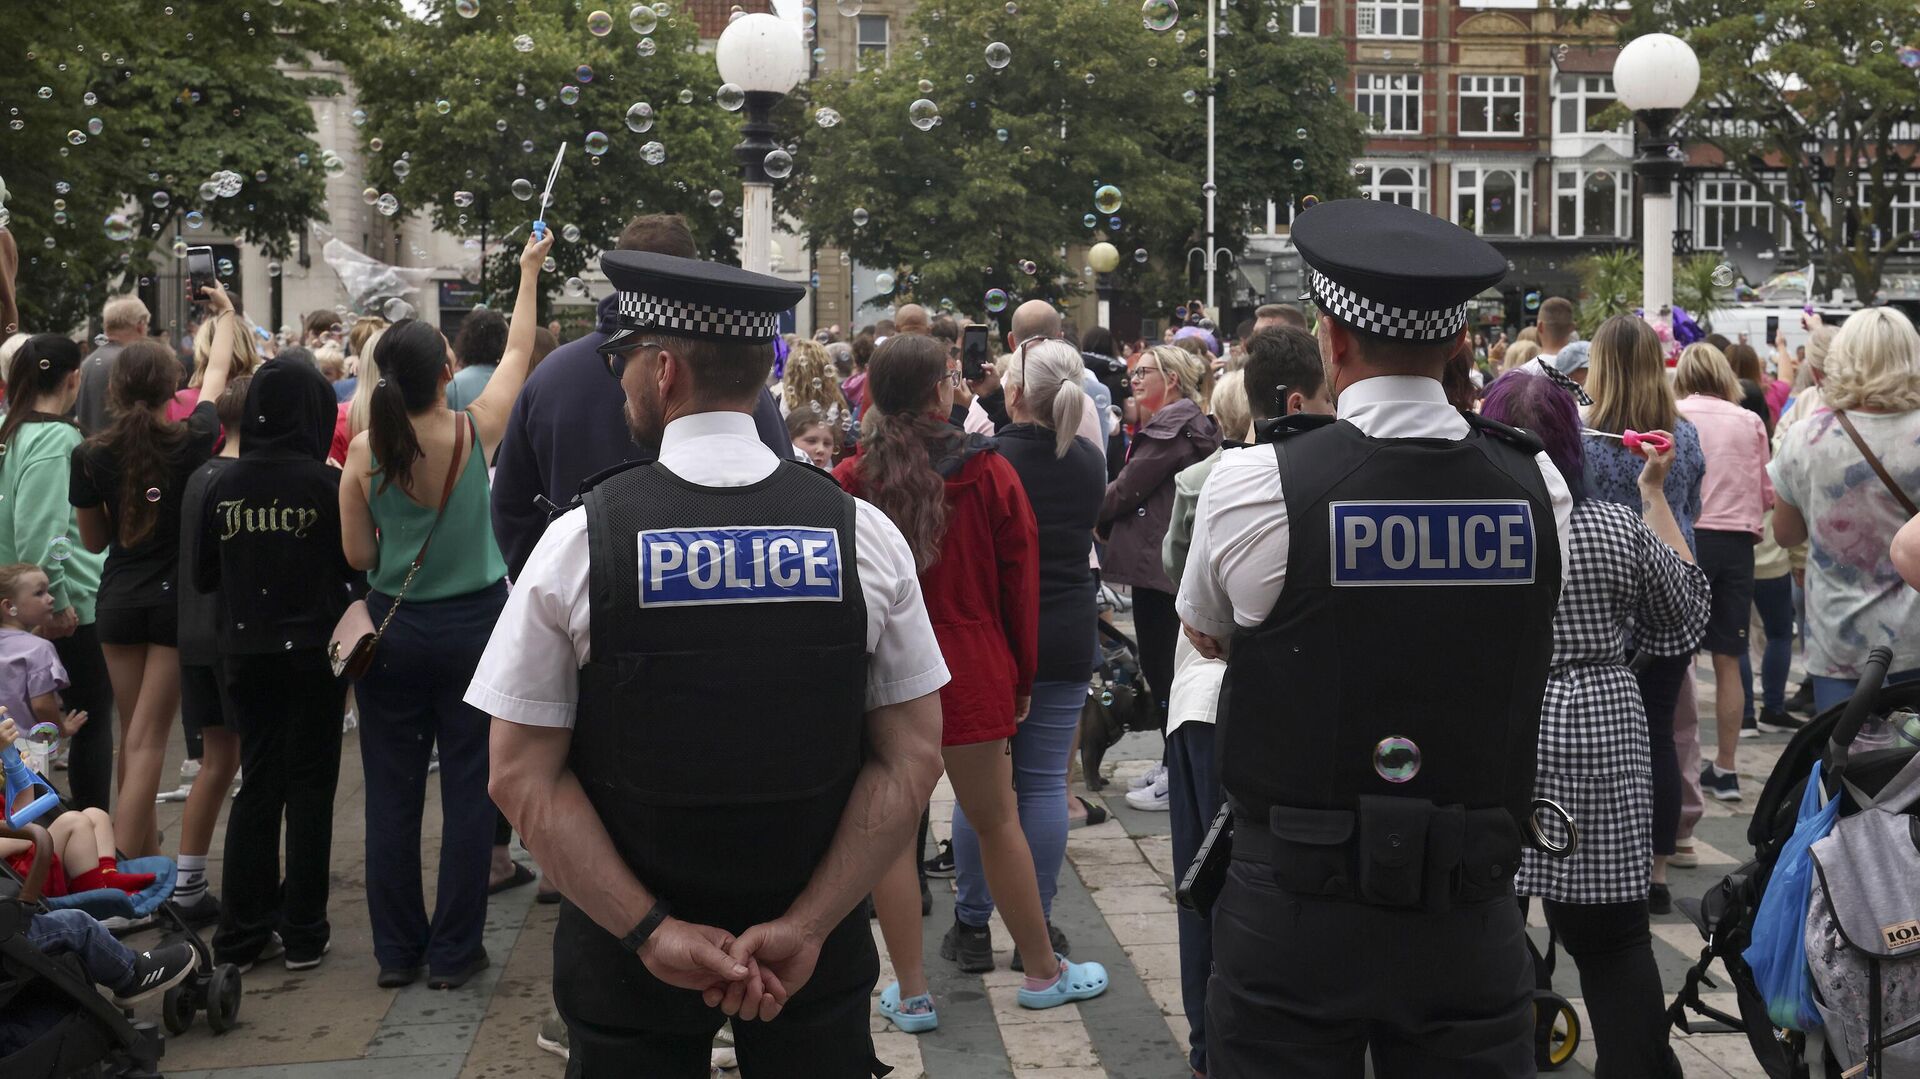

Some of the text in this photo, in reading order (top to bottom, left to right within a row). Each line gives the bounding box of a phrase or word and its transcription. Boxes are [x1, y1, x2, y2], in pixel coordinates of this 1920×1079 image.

[216, 498, 319, 541] Juicy
[1343, 515, 1526, 570] POLICE
[650, 537, 832, 591] POLICE
[1887, 926, 1920, 942] 101
